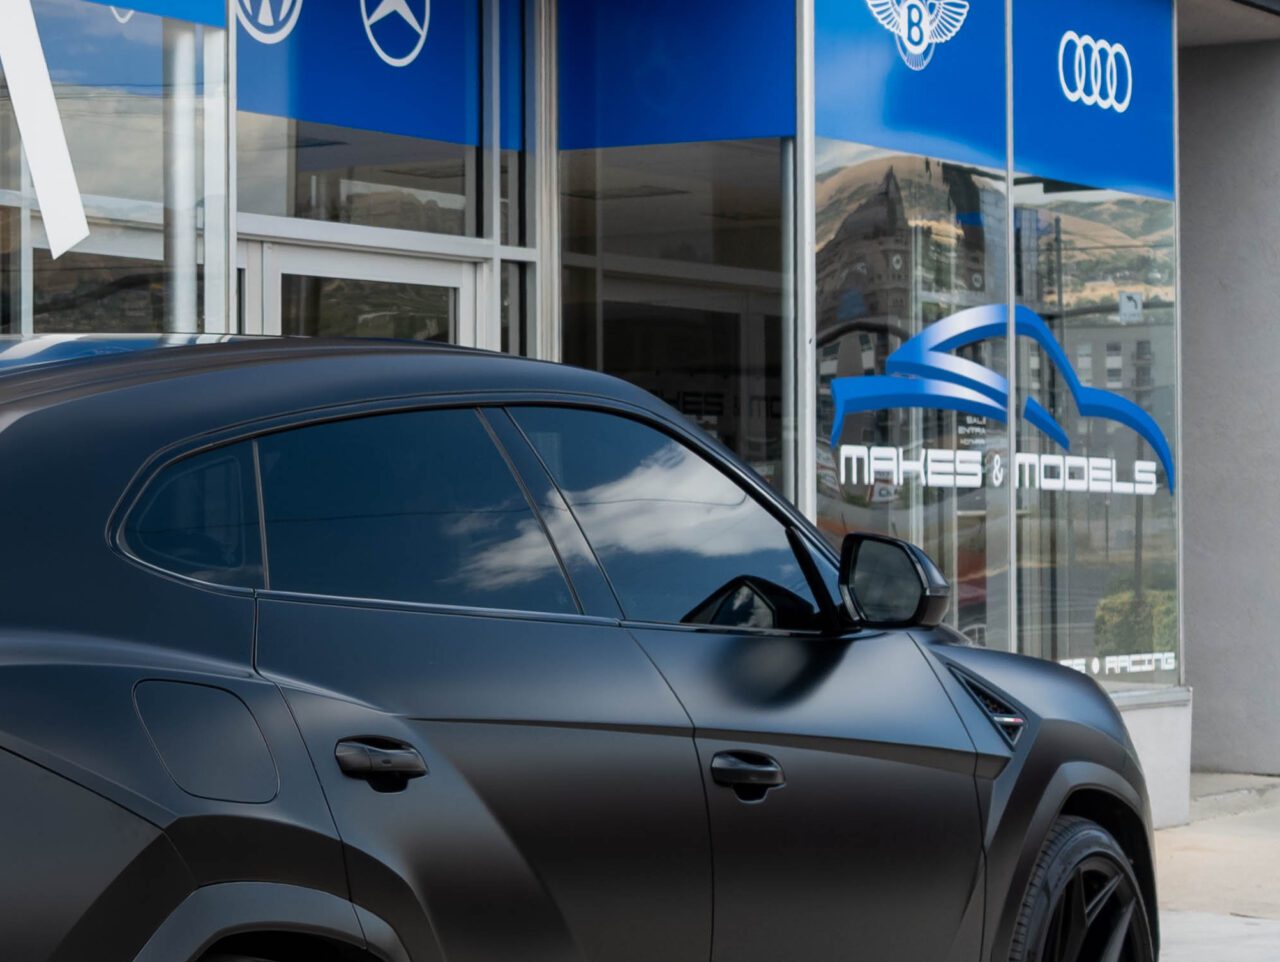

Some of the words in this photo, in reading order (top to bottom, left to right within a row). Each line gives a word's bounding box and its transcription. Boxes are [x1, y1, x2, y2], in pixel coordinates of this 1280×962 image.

[840, 445, 982, 488] MAKES
[992, 454, 1005, 488] &
[1015, 452, 1157, 496] MODELS
[1105, 652, 1175, 675] RACING
